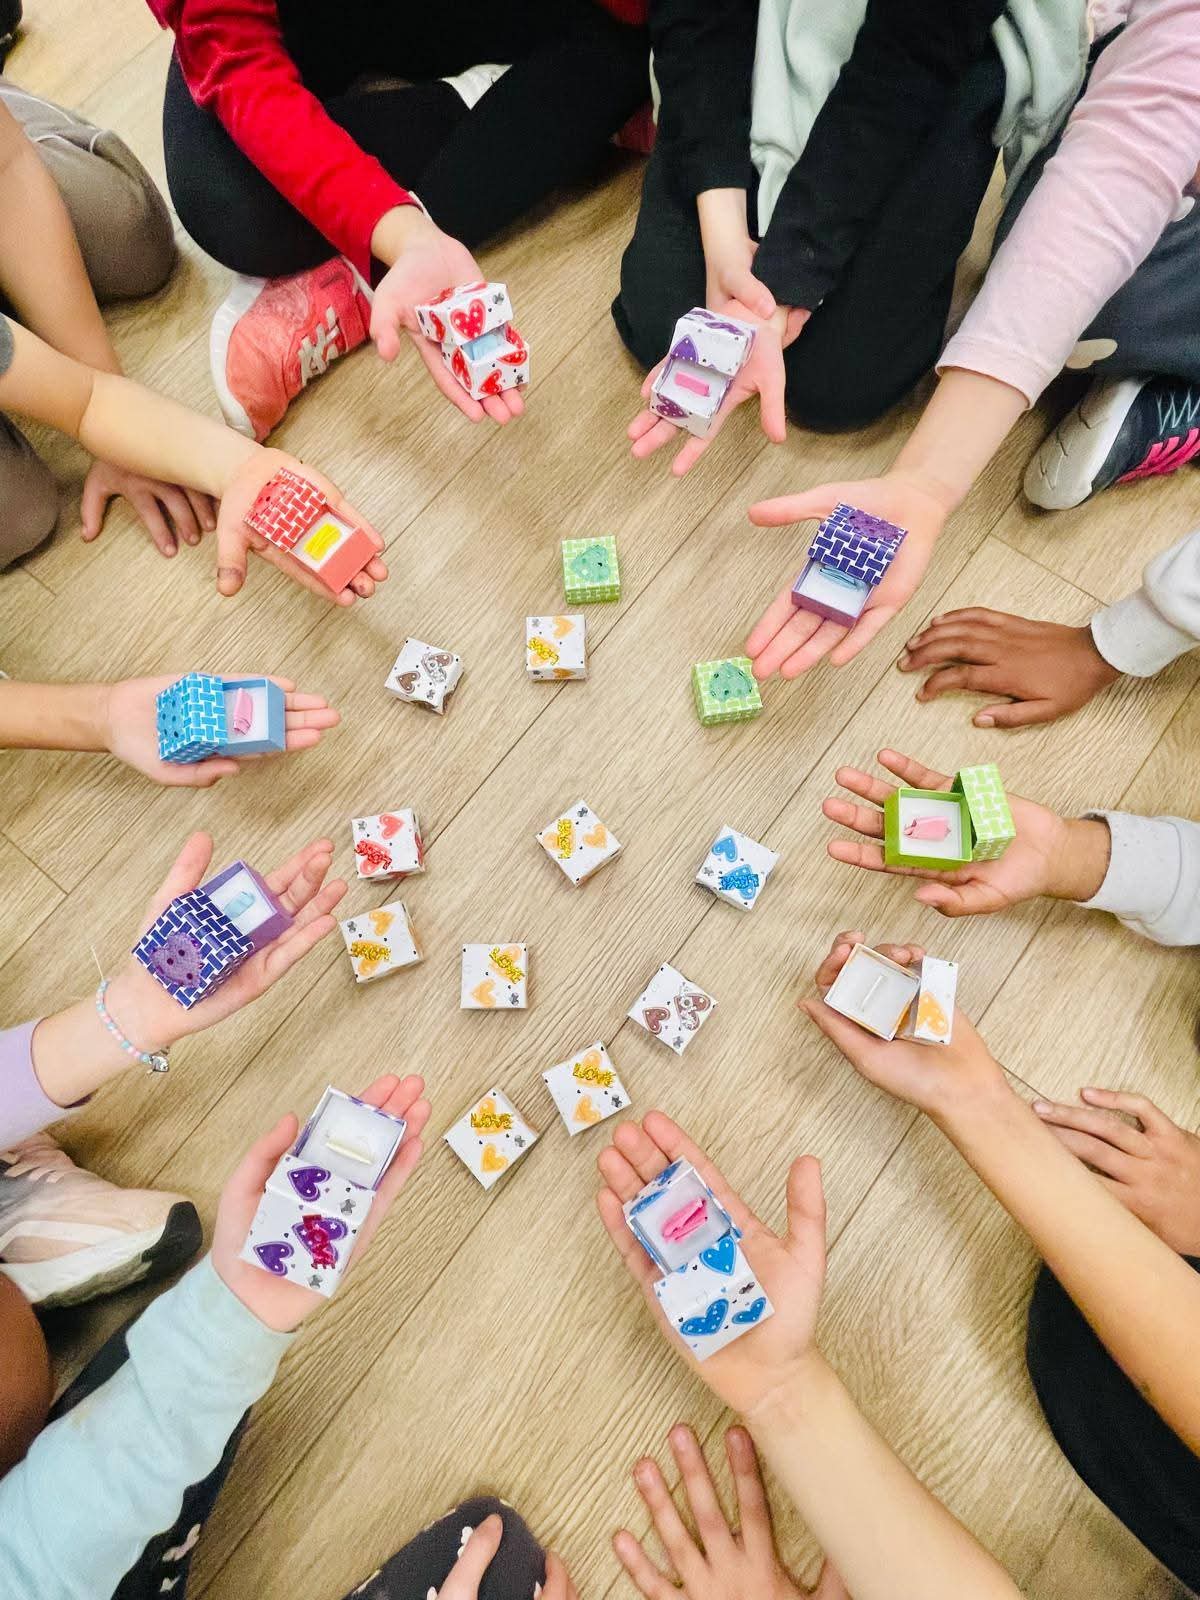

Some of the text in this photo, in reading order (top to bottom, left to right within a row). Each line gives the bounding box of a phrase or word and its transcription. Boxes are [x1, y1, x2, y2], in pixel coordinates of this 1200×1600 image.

[354, 840, 392, 870] LOVE
[489, 947, 525, 984] LOVE
[573, 1063, 616, 1087] LOVE
[470, 1112, 513, 1129] LOVE
[302, 1214, 336, 1269] LOVE
